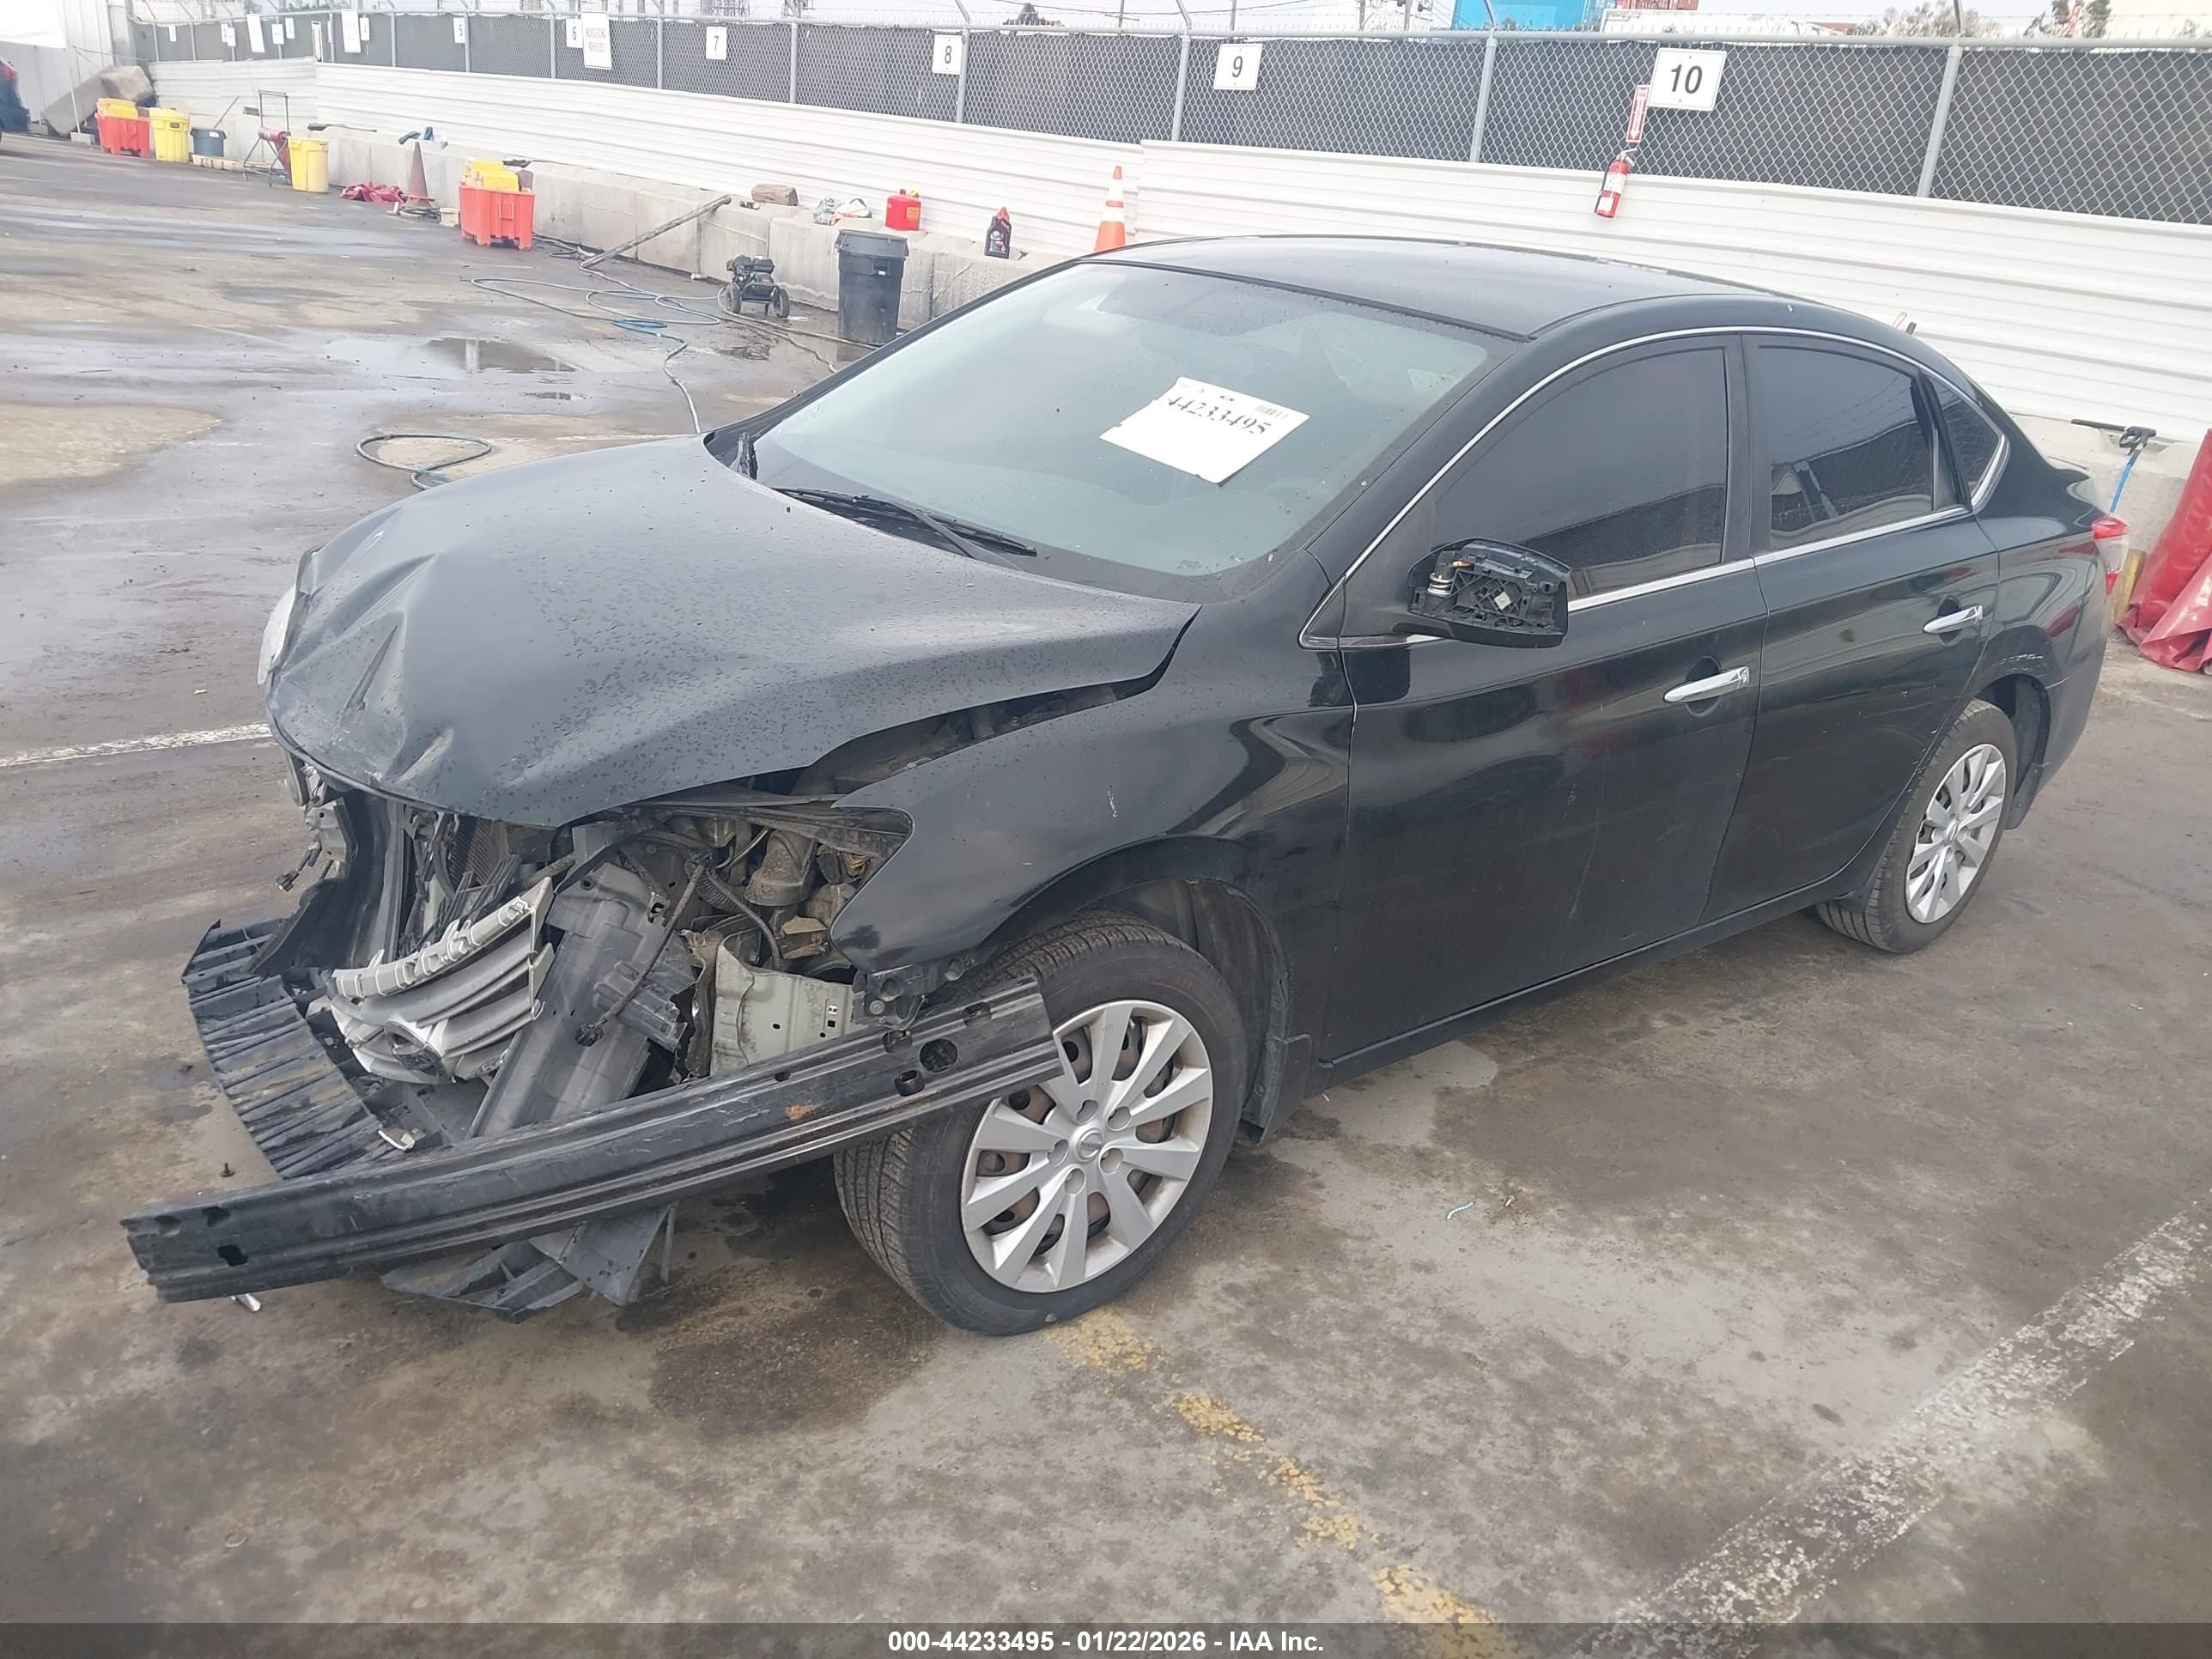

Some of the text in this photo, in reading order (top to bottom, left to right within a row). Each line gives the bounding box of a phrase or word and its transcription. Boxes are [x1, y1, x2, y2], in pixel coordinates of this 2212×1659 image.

[572, 26, 577, 41] 6
[714, 35, 720, 52] 7
[945, 46, 952, 64] 8
[1231, 56, 1243, 78] 9
[1670, 64, 1704, 94] 10
[1168, 396, 1272, 434] 44233495
